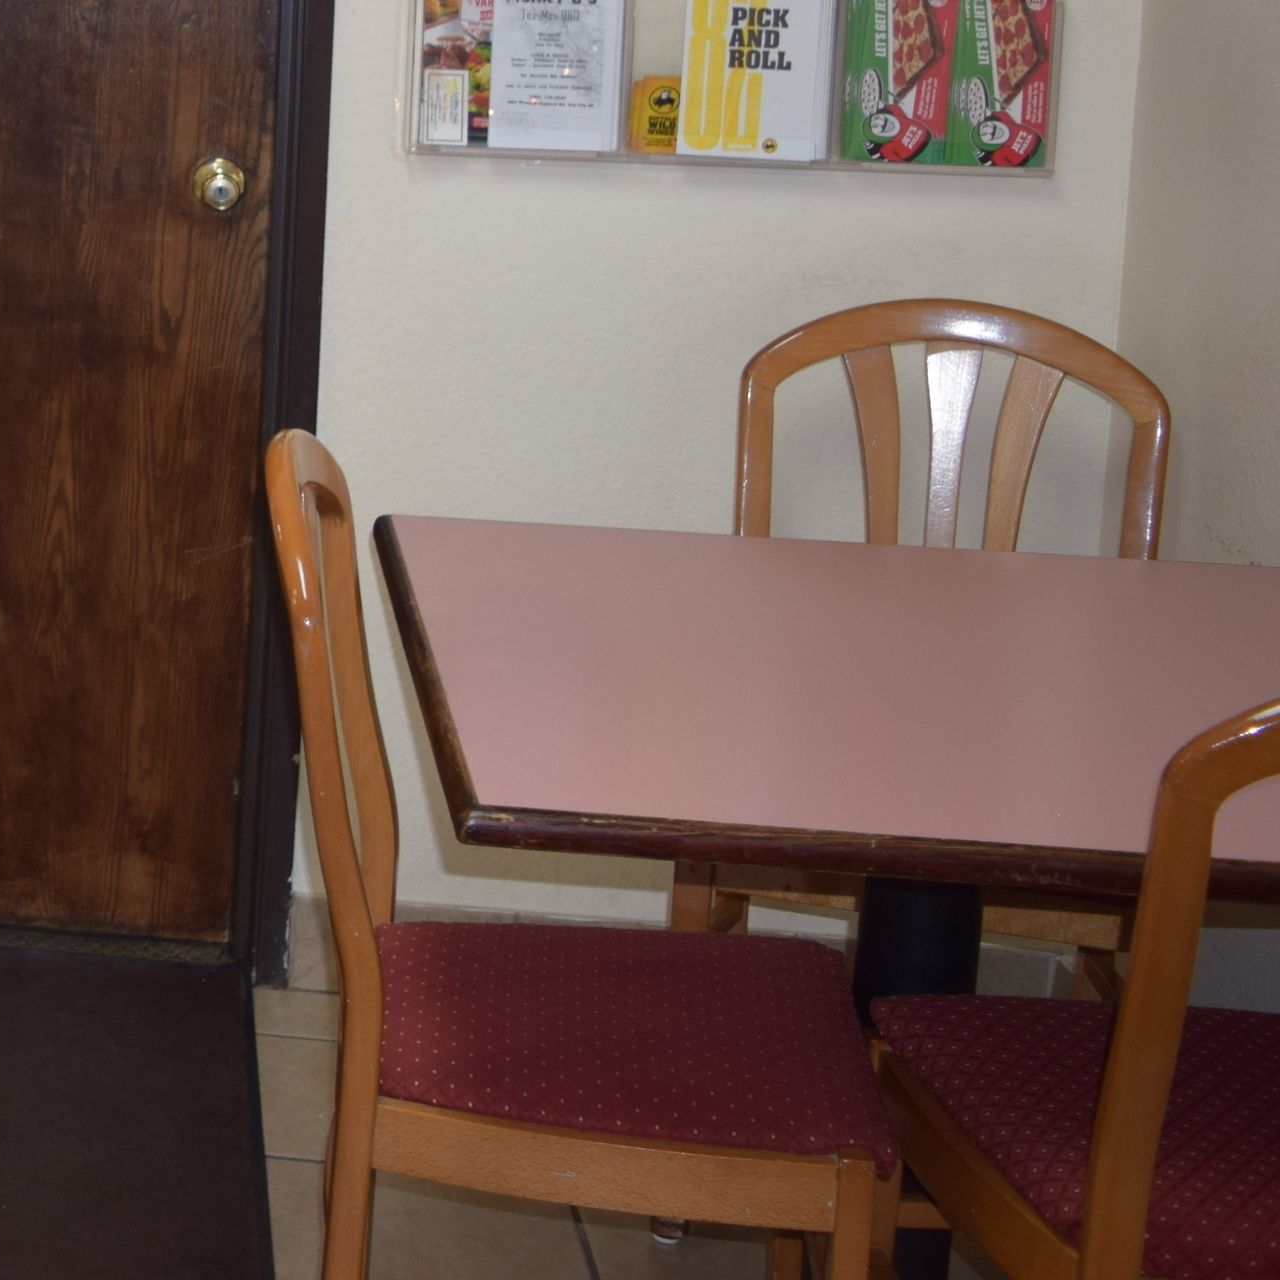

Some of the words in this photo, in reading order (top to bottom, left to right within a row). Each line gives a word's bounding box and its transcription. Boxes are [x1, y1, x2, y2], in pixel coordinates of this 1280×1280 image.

[731, 7, 790, 28] PICK
[874, 13, 886, 31] GET
[729, 29, 780, 48] AND
[975, 20, 987, 39] GET
[874, 33, 886, 57] LET'S
[976, 40, 990, 64] LET'S
[728, 49, 792, 71] ROLL
[649, 120, 676, 129] WILD
